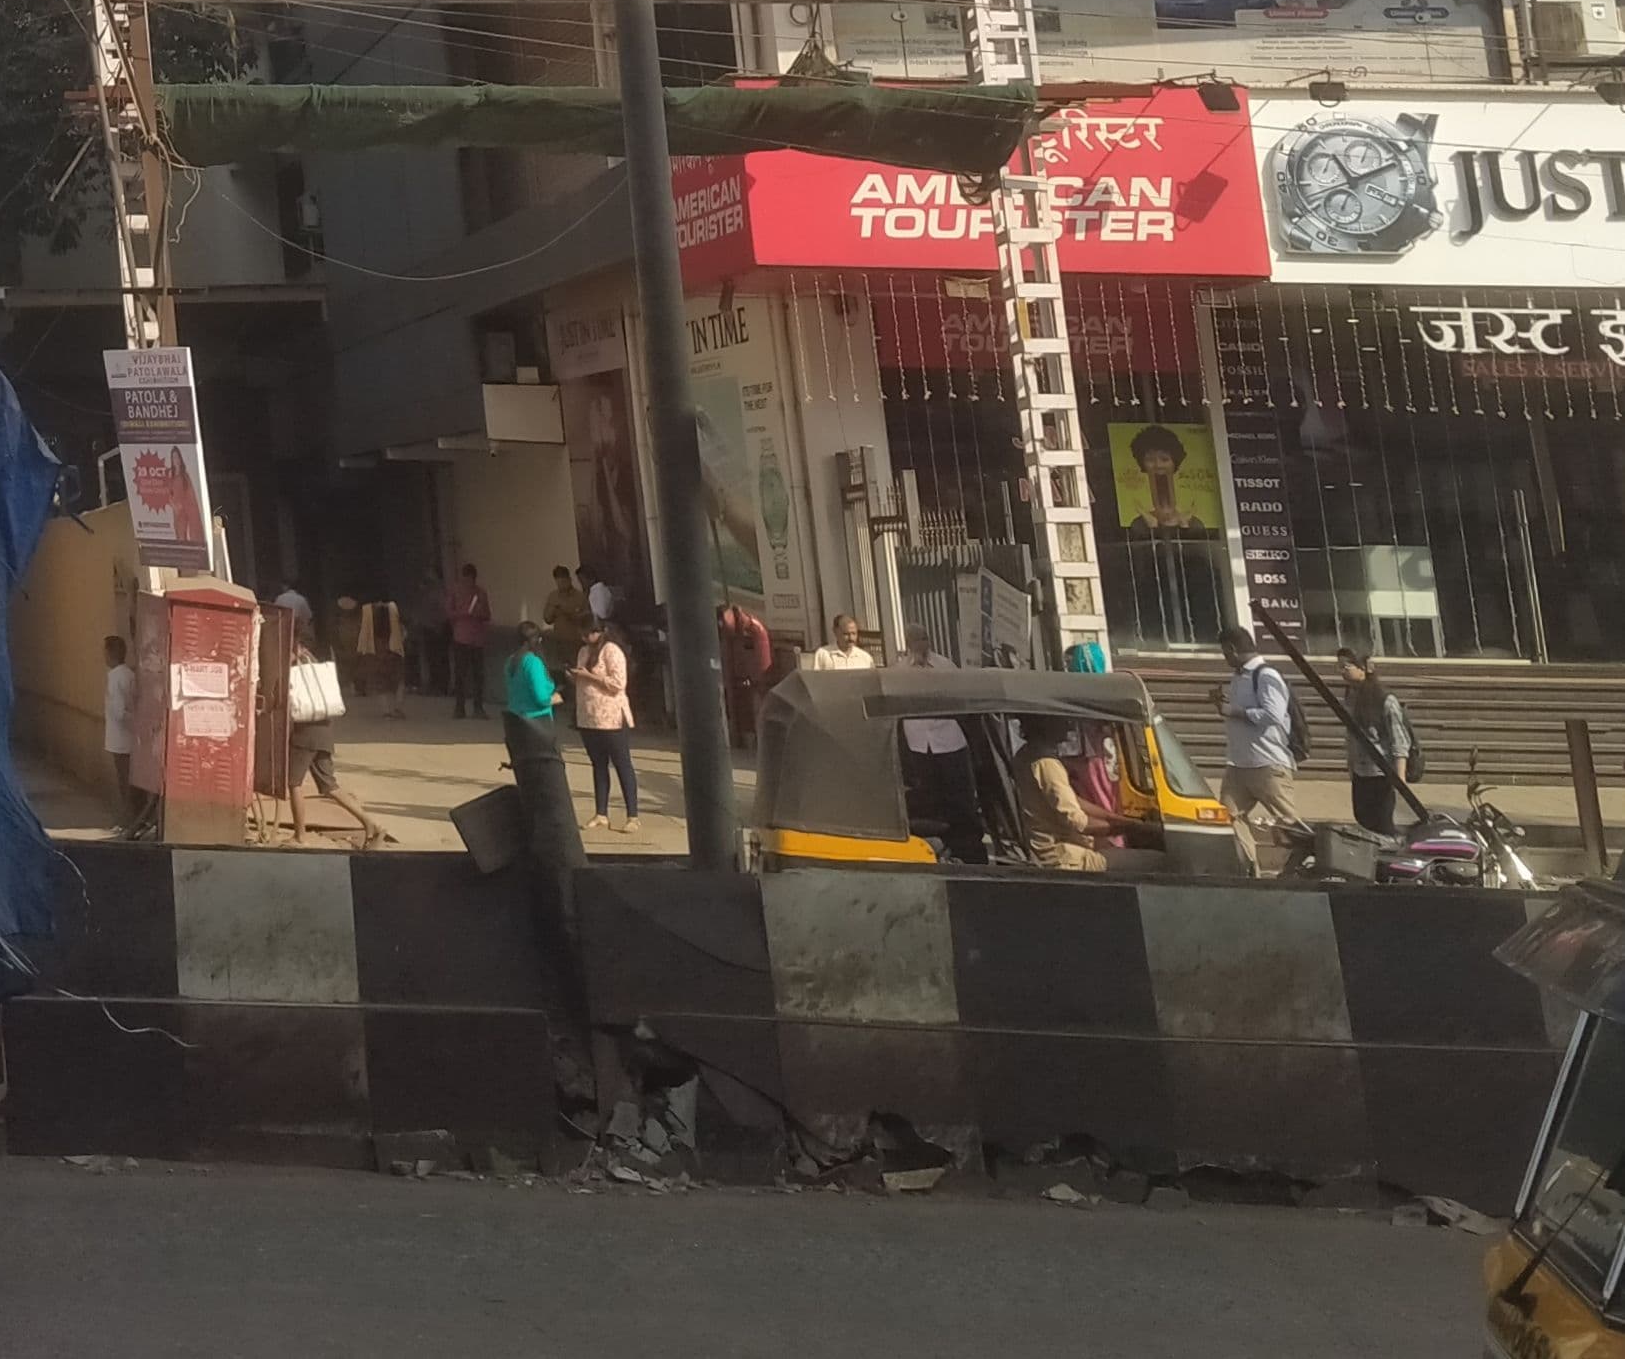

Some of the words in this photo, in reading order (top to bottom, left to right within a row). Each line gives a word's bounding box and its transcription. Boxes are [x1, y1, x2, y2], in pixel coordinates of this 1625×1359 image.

[676, 204, 745, 250] OURISTER
[708, 306, 750, 350] TIME
[1409, 297, 1573, 355] जस्ट
[124, 390, 167, 404] PATOLA
[169, 390, 178, 403] &
[127, 404, 178, 419] BANDHEJ
[1235, 478, 1281, 489] TISSOT
[1240, 502, 1283, 513] RADO
[1241, 525, 1288, 537] GUESS
[1245, 549, 1291, 561] SEIKO
[1254, 573, 1287, 585] BOSS
